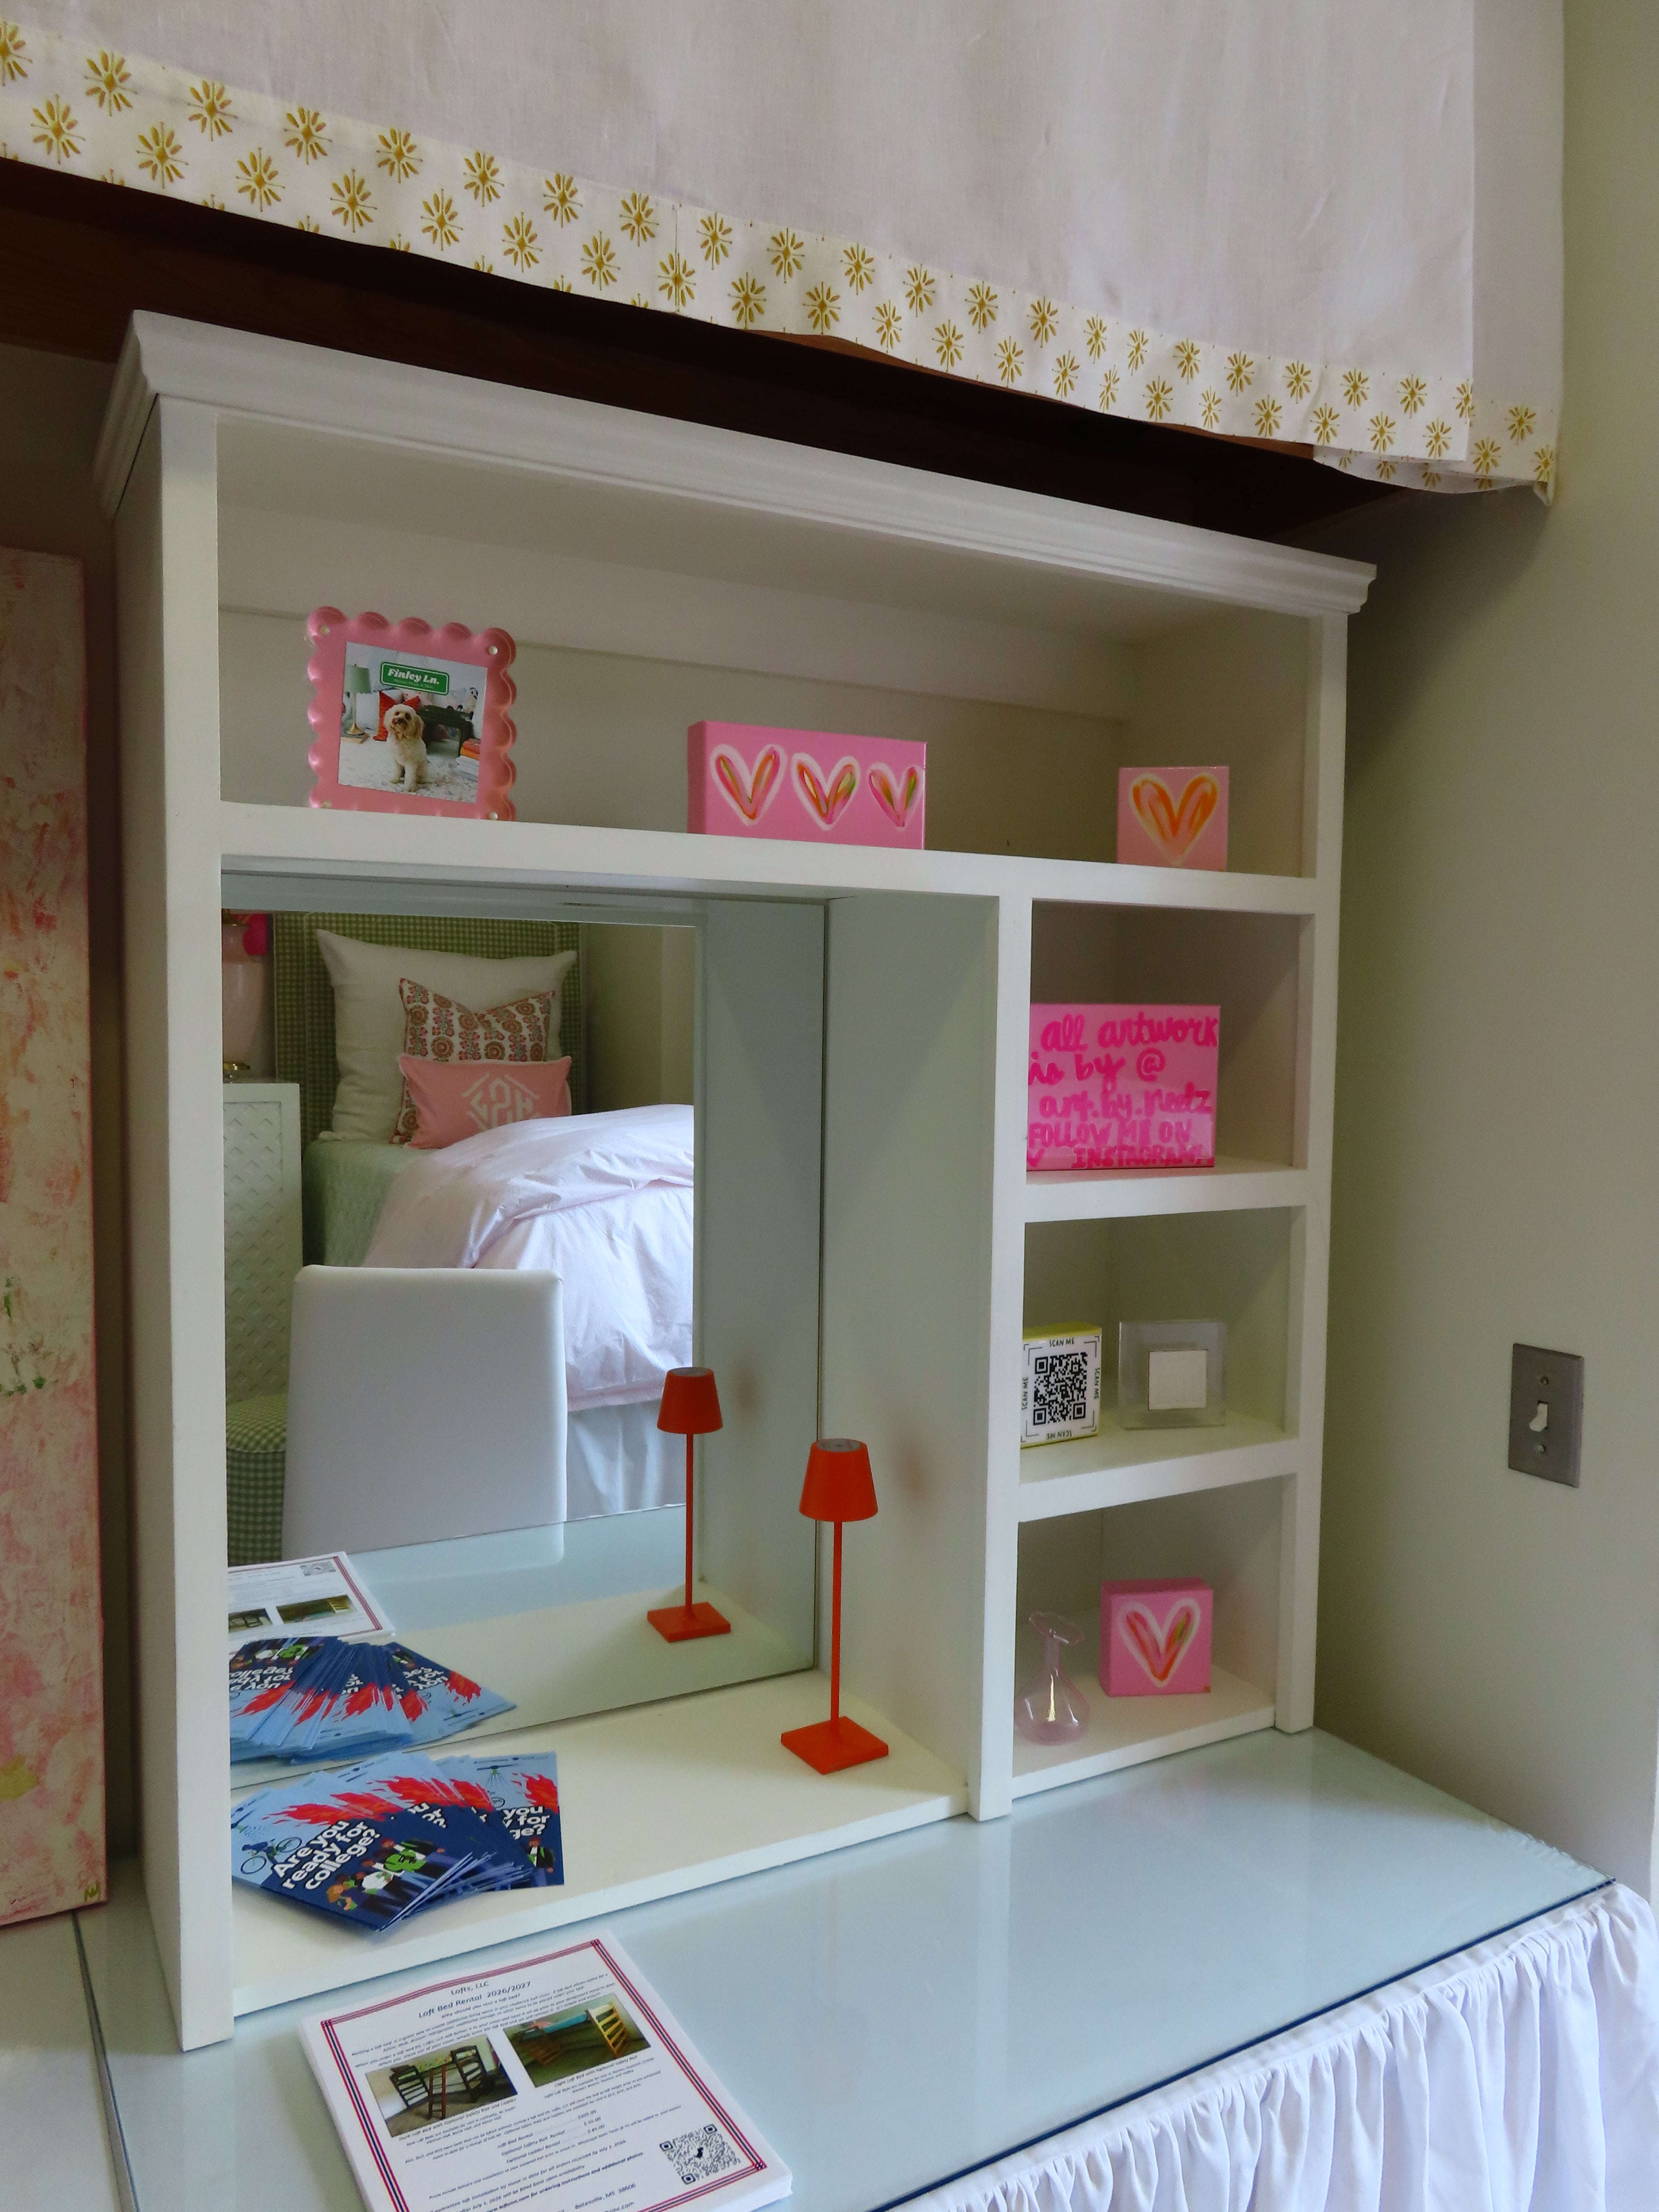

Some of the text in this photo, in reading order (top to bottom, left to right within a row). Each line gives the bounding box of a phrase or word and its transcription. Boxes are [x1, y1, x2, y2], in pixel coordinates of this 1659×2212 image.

[387, 668, 422, 682] Finley
[423, 674, 439, 684] Ln.
[1040, 1011, 1219, 1052] all artwork
[1028, 1048, 1166, 1093] is by @
[1158, 1119, 1192, 1144] ON
[1023, 1377, 1028, 1388] ME
[1094, 1388, 1100, 1400] ME
[503, 1805, 543, 1820] you
[517, 1814, 550, 1826] for
[274, 1821, 350, 1877] Are you
[282, 1822, 368, 1889] ready for
[305, 1828, 381, 1890] college?
[418, 1981, 531, 2018] Loft Bed Rental 2026/2027
[451, 1986, 473, 1995] Lofts,
